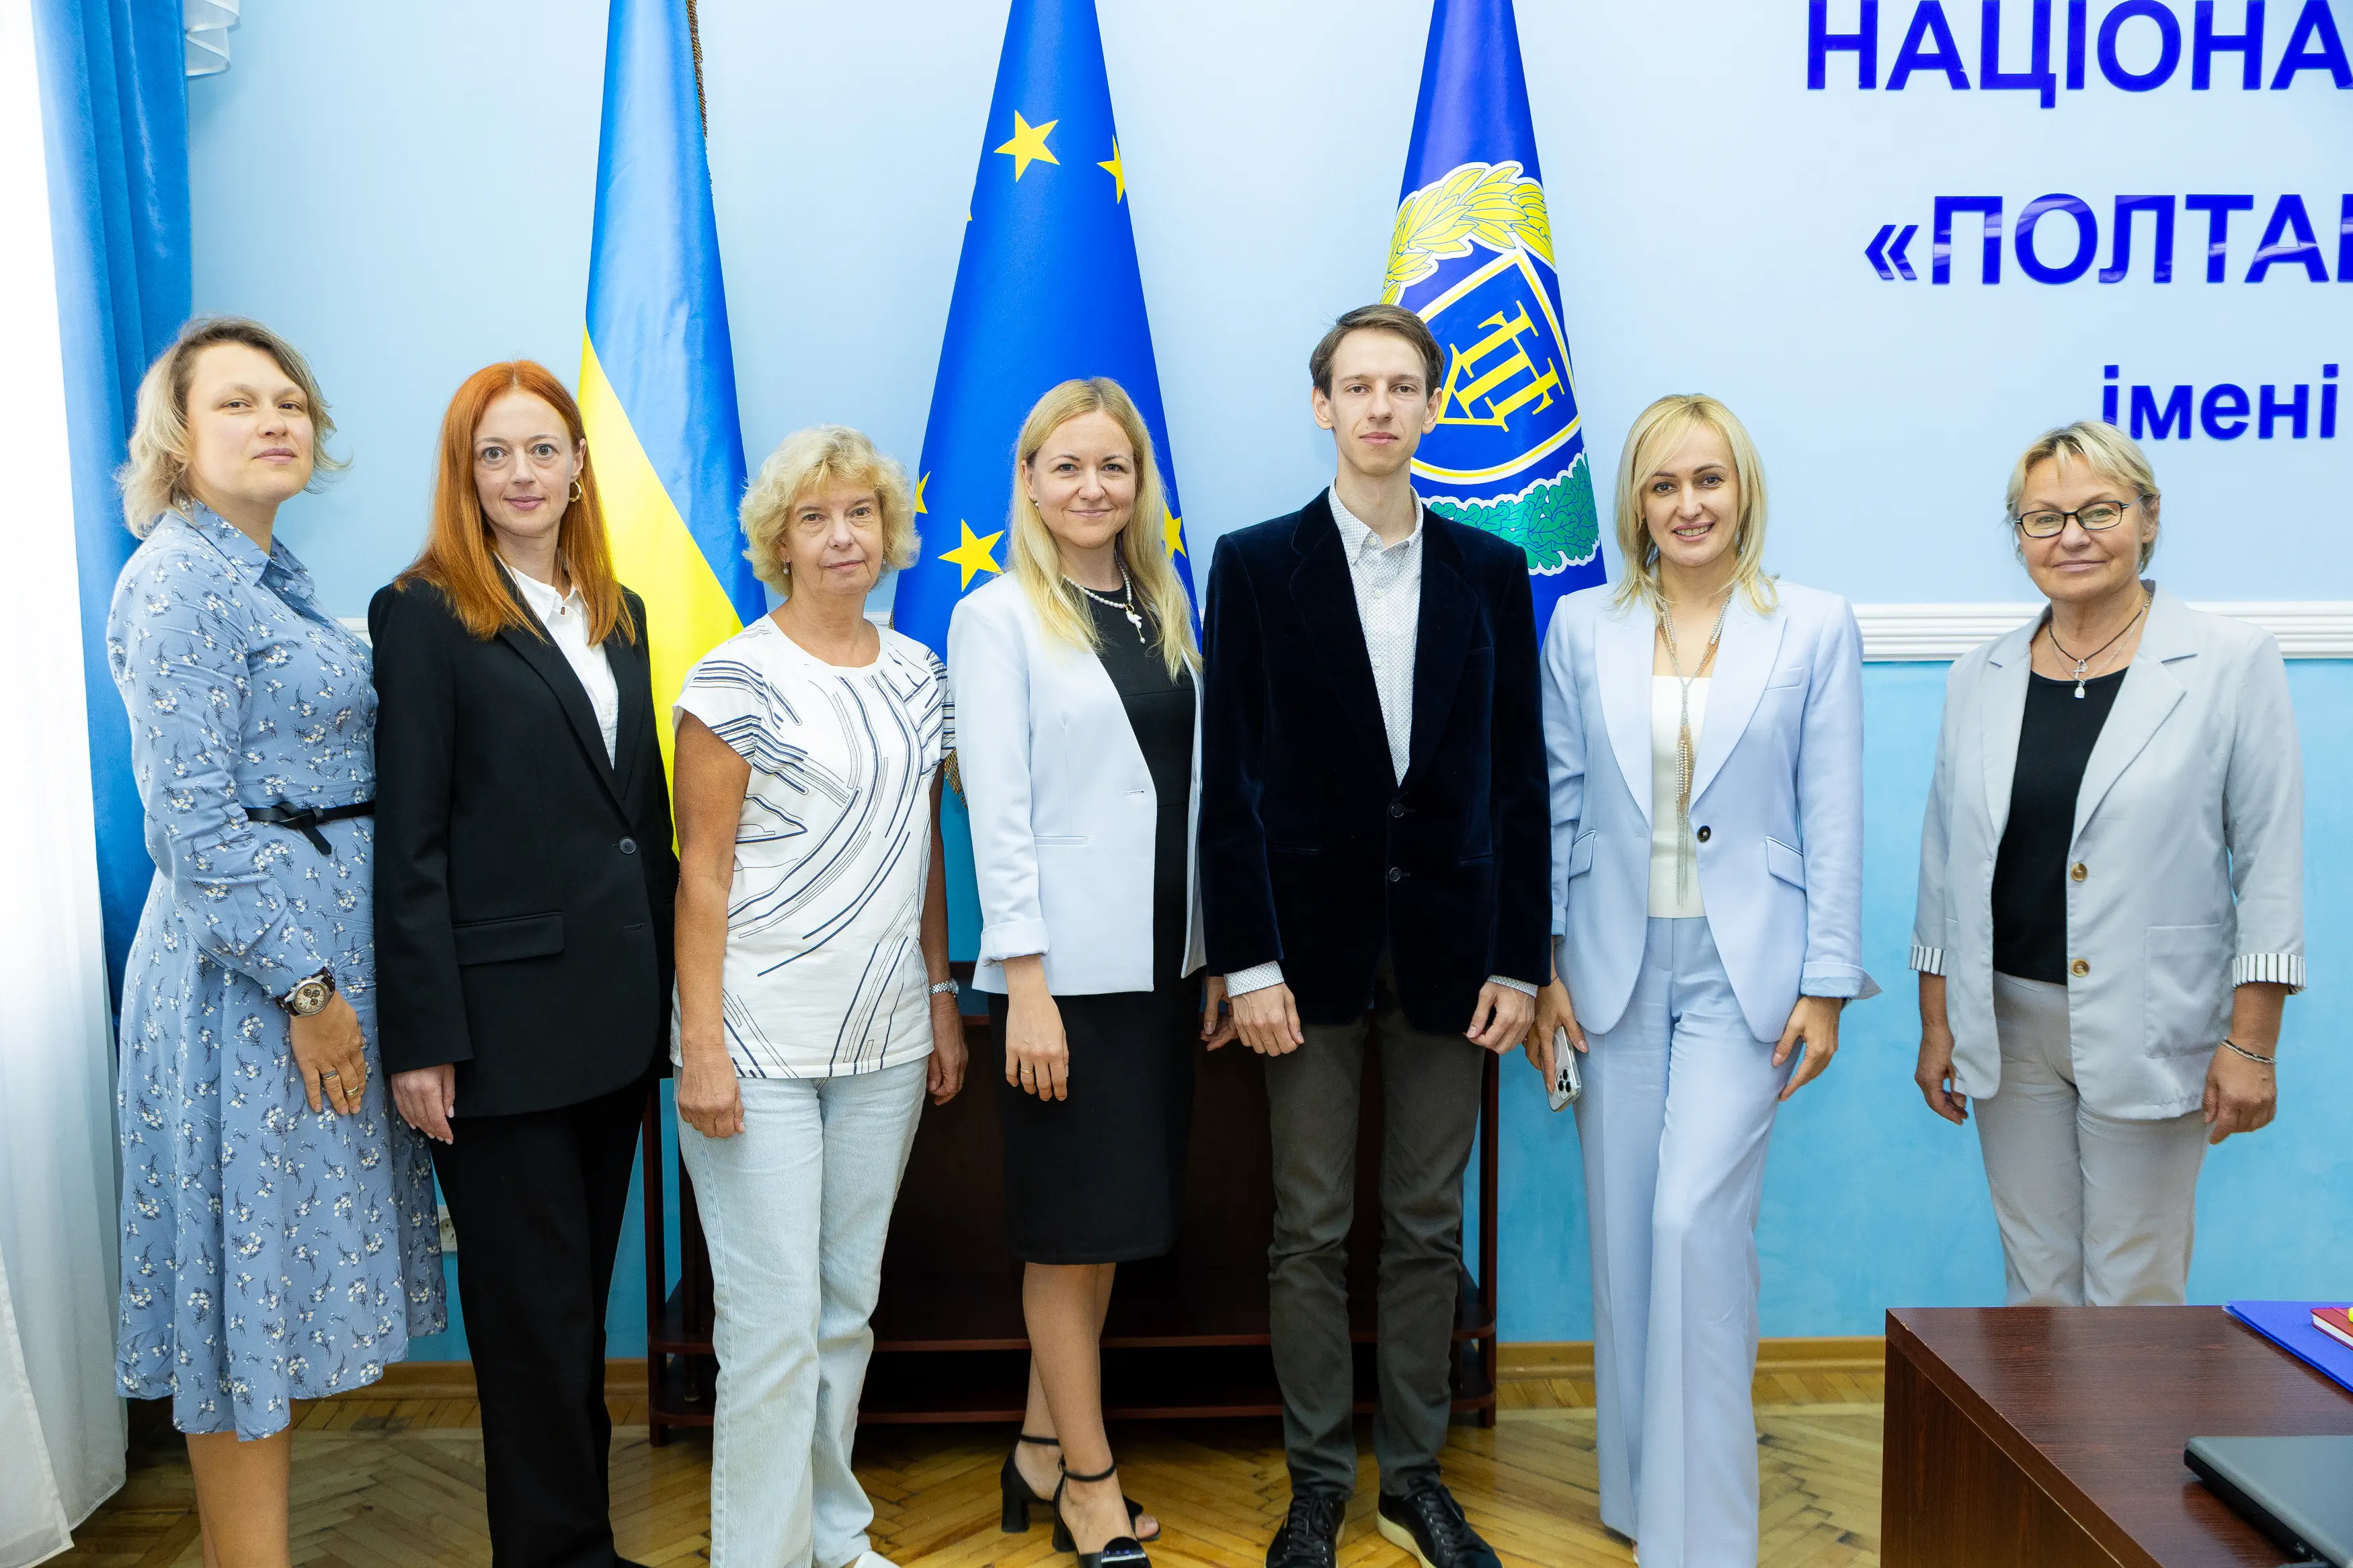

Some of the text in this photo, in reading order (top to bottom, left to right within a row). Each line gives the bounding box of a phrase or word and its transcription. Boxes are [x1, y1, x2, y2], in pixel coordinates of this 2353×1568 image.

[1807, 0, 2353, 108] НАЦІОНА
[1864, 193, 2353, 285] «ПОЛТА
[2102, 364, 2339, 440] імені
